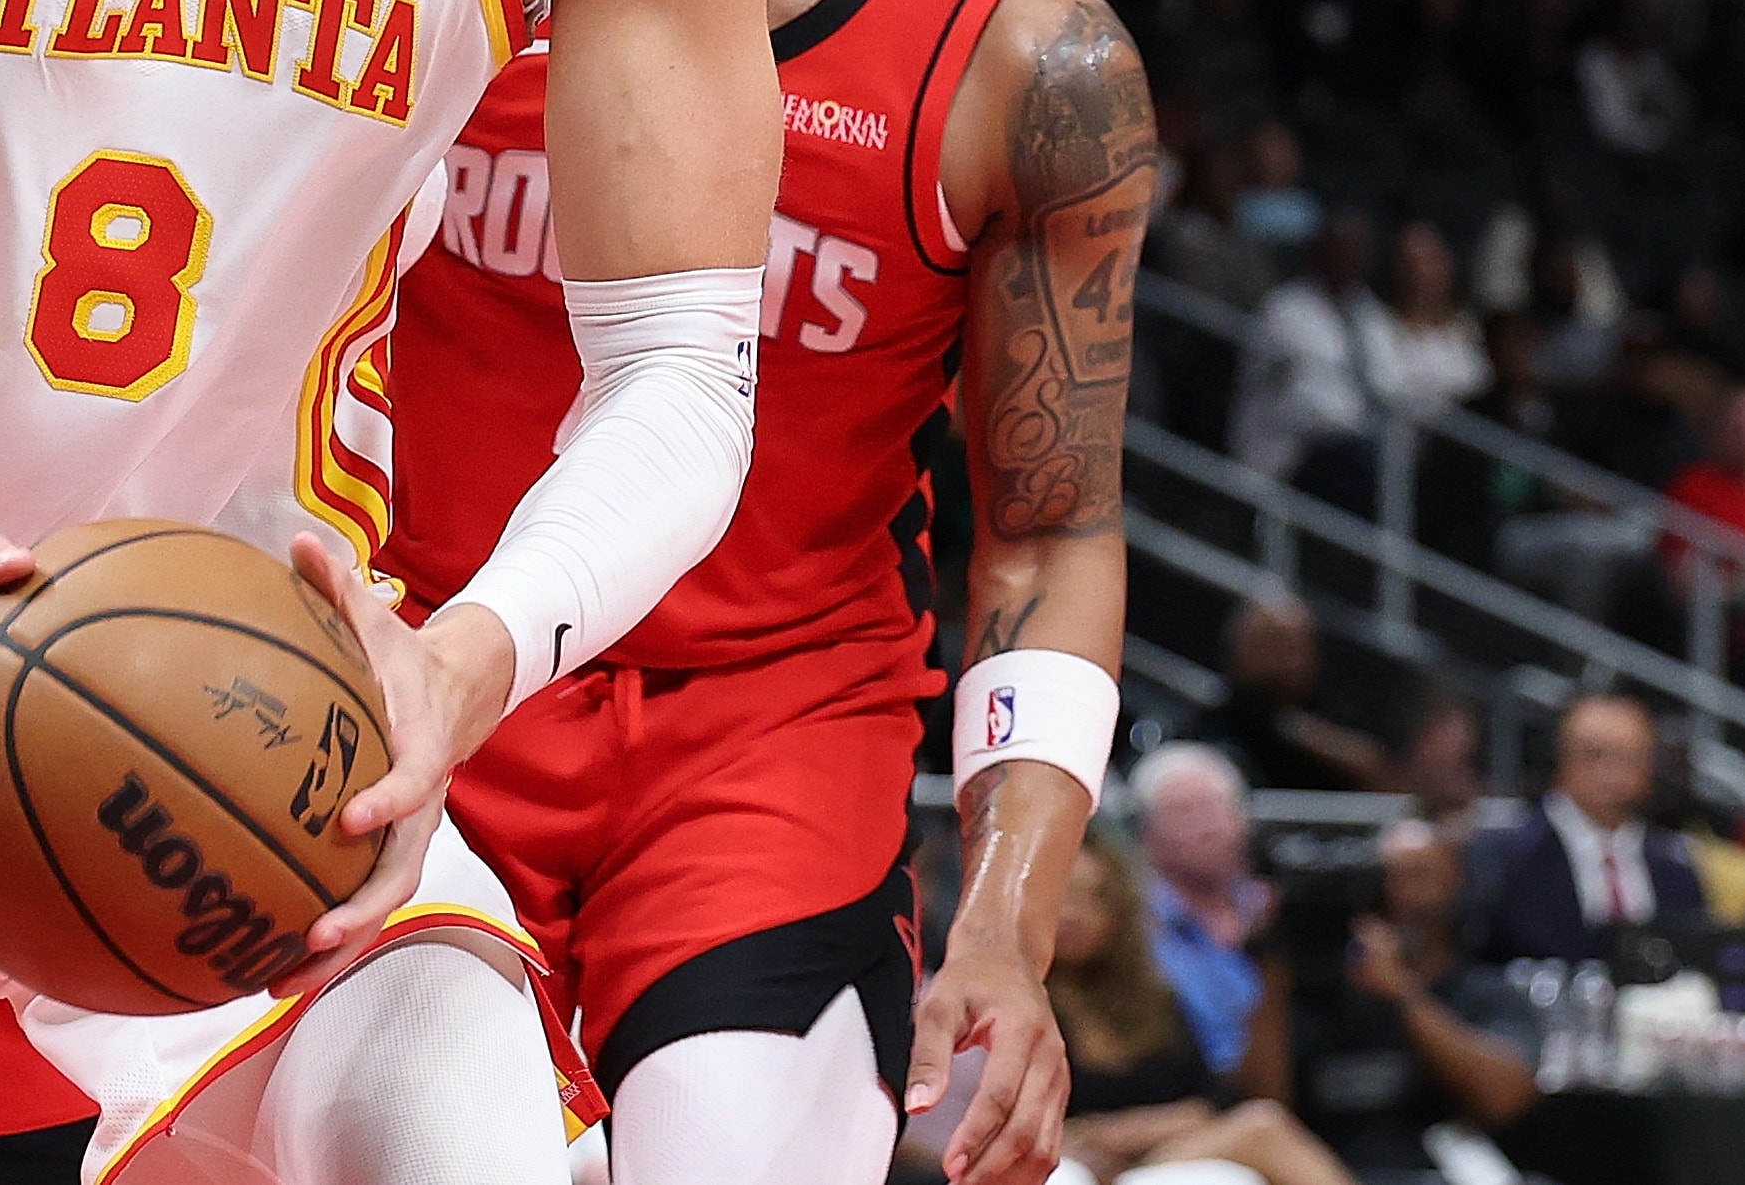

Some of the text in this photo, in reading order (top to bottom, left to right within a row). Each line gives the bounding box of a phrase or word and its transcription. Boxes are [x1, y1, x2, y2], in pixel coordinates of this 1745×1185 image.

[780, 92, 888, 136] EMORIAL
[782, 112, 887, 150] ERMANN
[23, 149, 213, 402] 8
